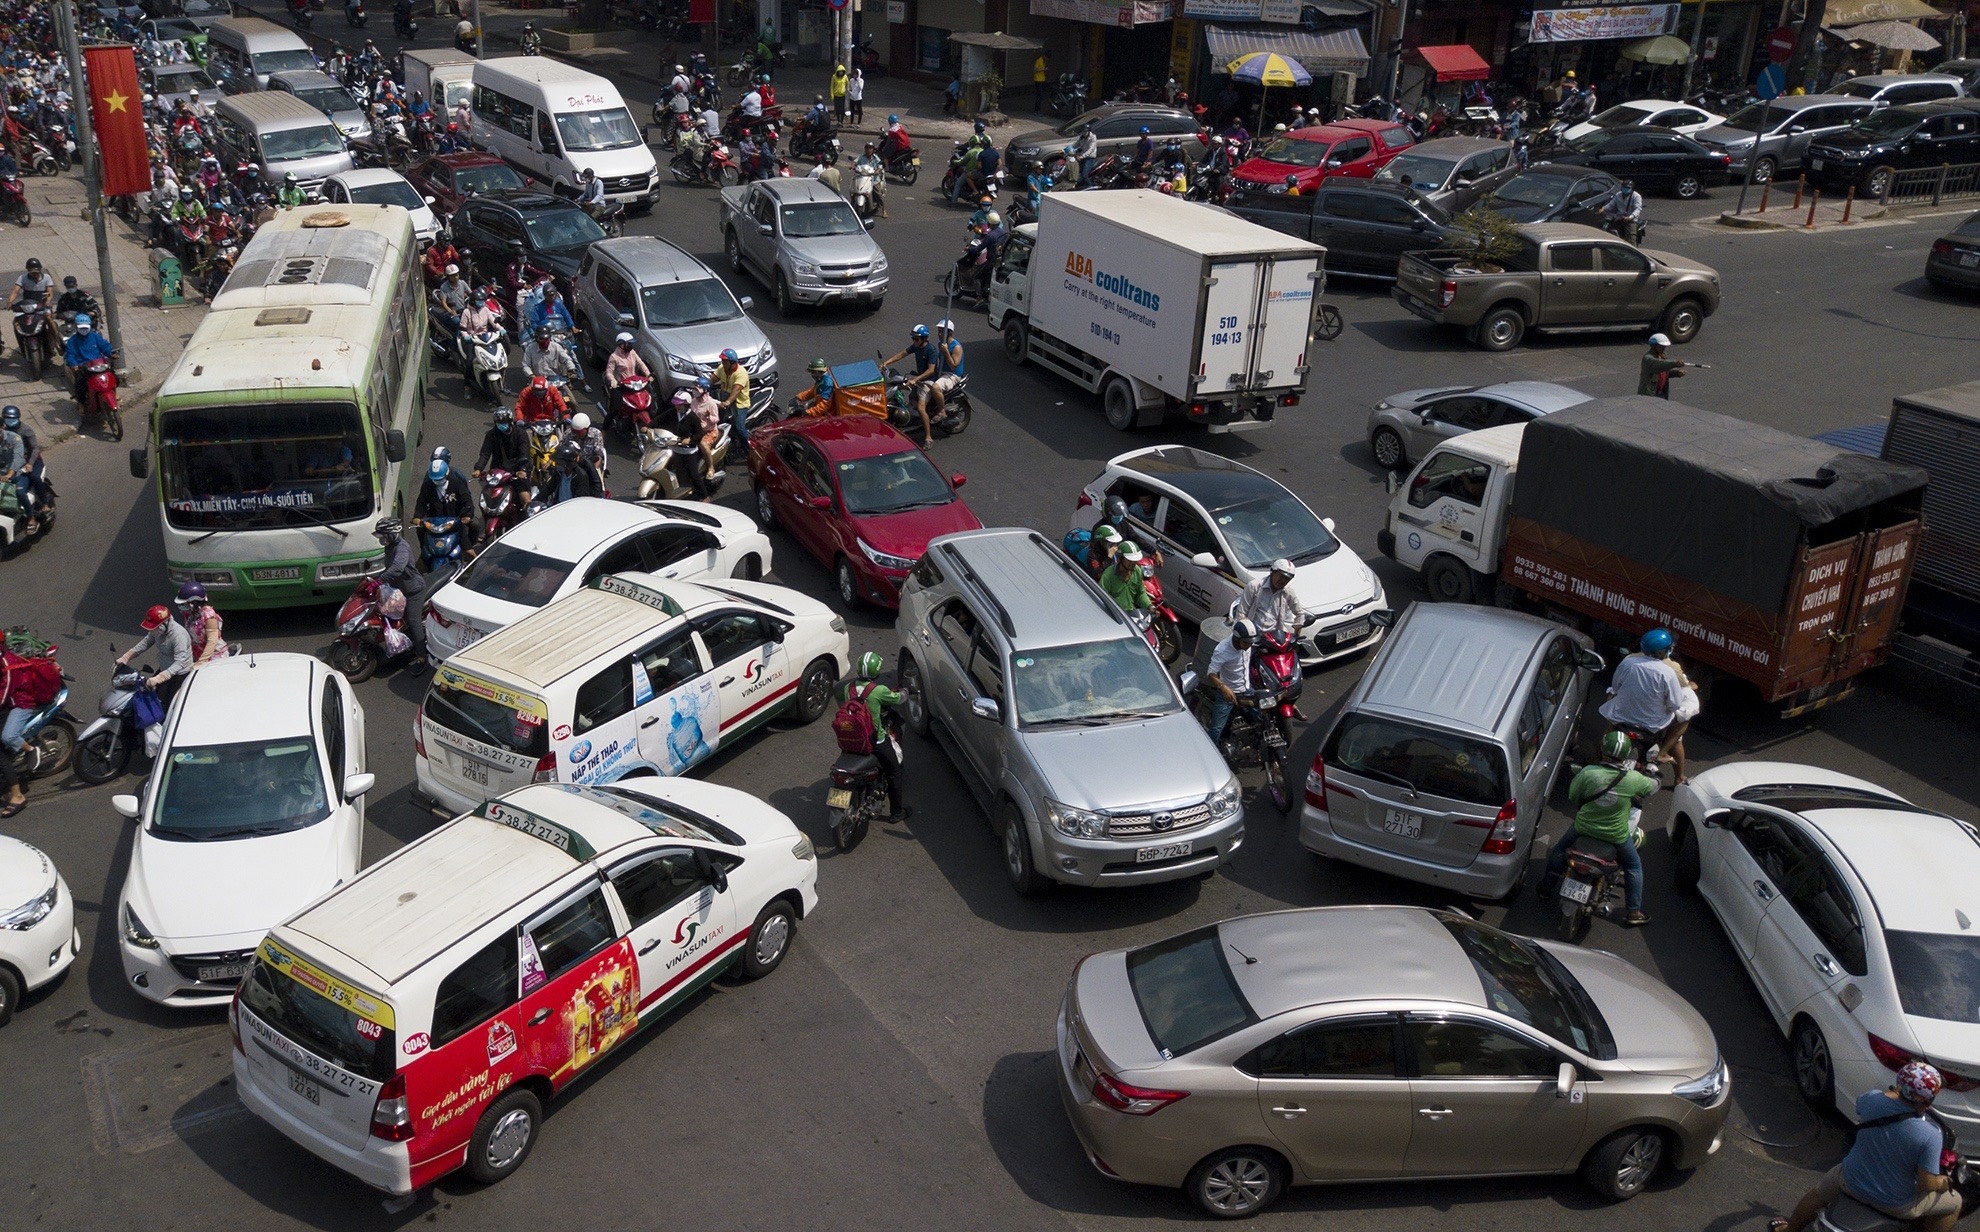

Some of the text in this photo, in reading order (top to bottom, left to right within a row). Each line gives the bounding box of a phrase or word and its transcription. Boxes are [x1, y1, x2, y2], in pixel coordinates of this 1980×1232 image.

[1066, 251, 1160, 311] ABA cooltrans
[1064, 279, 1157, 328] Carry at the right temperature
[1220, 316, 1237, 329] 51D
[277, 491, 295, 507] SUỐI
[295, 491, 314, 505] TIÊN
[1515, 556, 1567, 582] 0933 591 281
[1808, 559, 1848, 583] DỊCH VỤ
[1525, 570, 1538, 580] 667
[1540, 575, 1554, 587] 360
[1555, 582, 1565, 591] 60
[615, 584, 638, 600] 38.27
[640, 593, 650, 602] 27
[651, 597, 662, 607] 27
[1571, 576, 1635, 616] THÀNH HƯNG
[1798, 610, 1835, 631] TRỌN GÓI
[1638, 603, 1658, 620] DỊCH
[1660, 612, 1671, 625] VỤ
[1707, 631, 1725, 648] NHÀ
[1727, 639, 1752, 658] TRỌN
[1752, 650, 1770, 666] GÓI
[494, 691, 515, 706] 15.5%
[477, 745, 502, 760] 38.27
[505, 754, 517, 765] 27
[519, 758, 533, 770] 27
[601, 740, 618, 760] THAO
[1393, 811, 1413, 825] 51F
[505, 814, 537, 833] 38.27
[539, 826, 553, 839] 27
[553, 833, 568, 847] 27
[328, 985, 352, 1006] 15.5%
[356, 1018, 382, 1038] 8043
[404, 1033, 428, 1054] 8043
[306, 1055, 338, 1080] 38.27
[340, 1073, 355, 1088] 27
[358, 1081, 375, 1096] 27
[441, 1091, 459, 1108] dầu
[479, 1081, 496, 1102] tài
